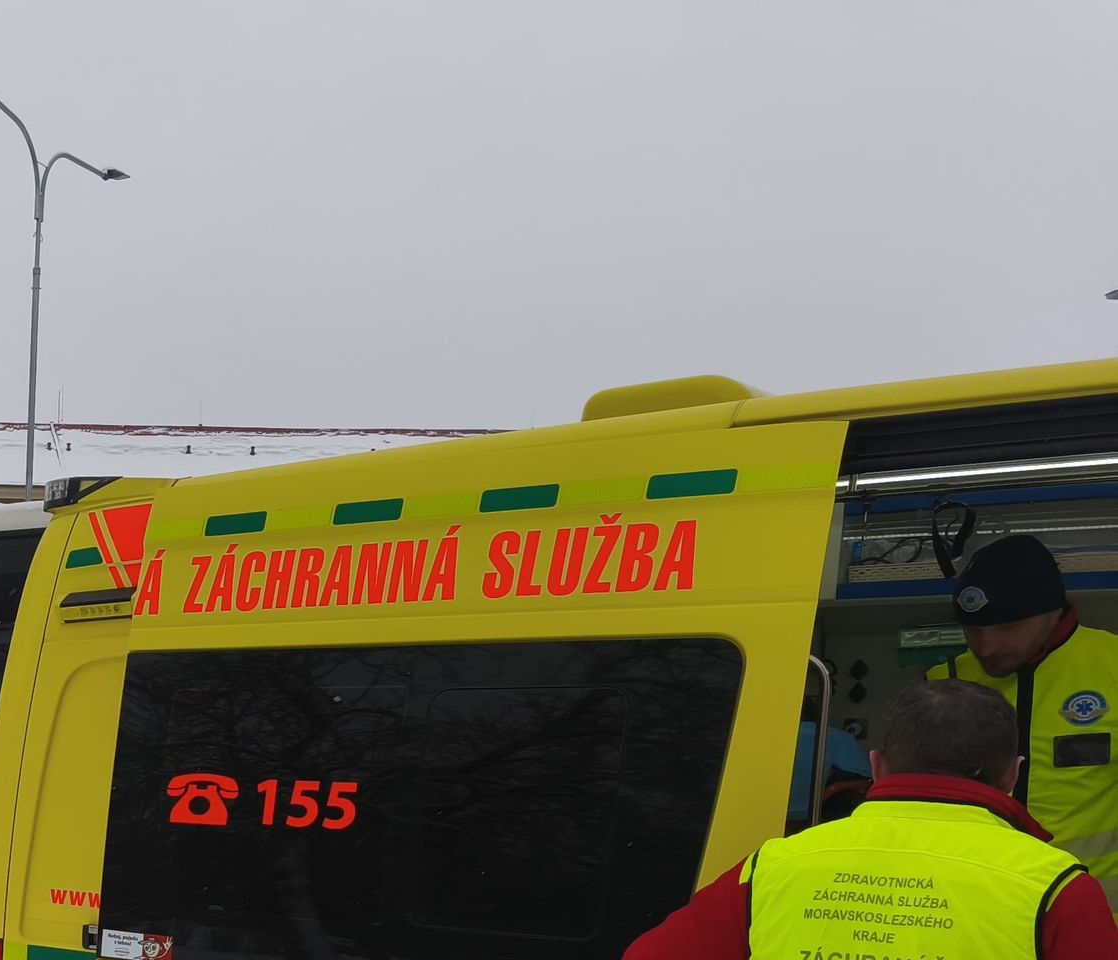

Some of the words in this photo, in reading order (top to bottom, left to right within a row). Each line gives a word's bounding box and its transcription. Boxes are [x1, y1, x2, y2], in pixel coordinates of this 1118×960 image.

[182, 524, 462, 614] ZÁCHRANNÁ
[481, 512, 698, 600] SLUŽBA
[257, 779, 358, 830] 155
[833, 872, 935, 889] ZDRAVOTNICKÁ
[813, 888, 894, 907] ZÁCHRANNÁ
[897, 895, 949, 910] SLUŽBA
[803, 908, 954, 930] MORAVSKOSLEZSKÉHO
[852, 930, 896, 944] KRAJE
